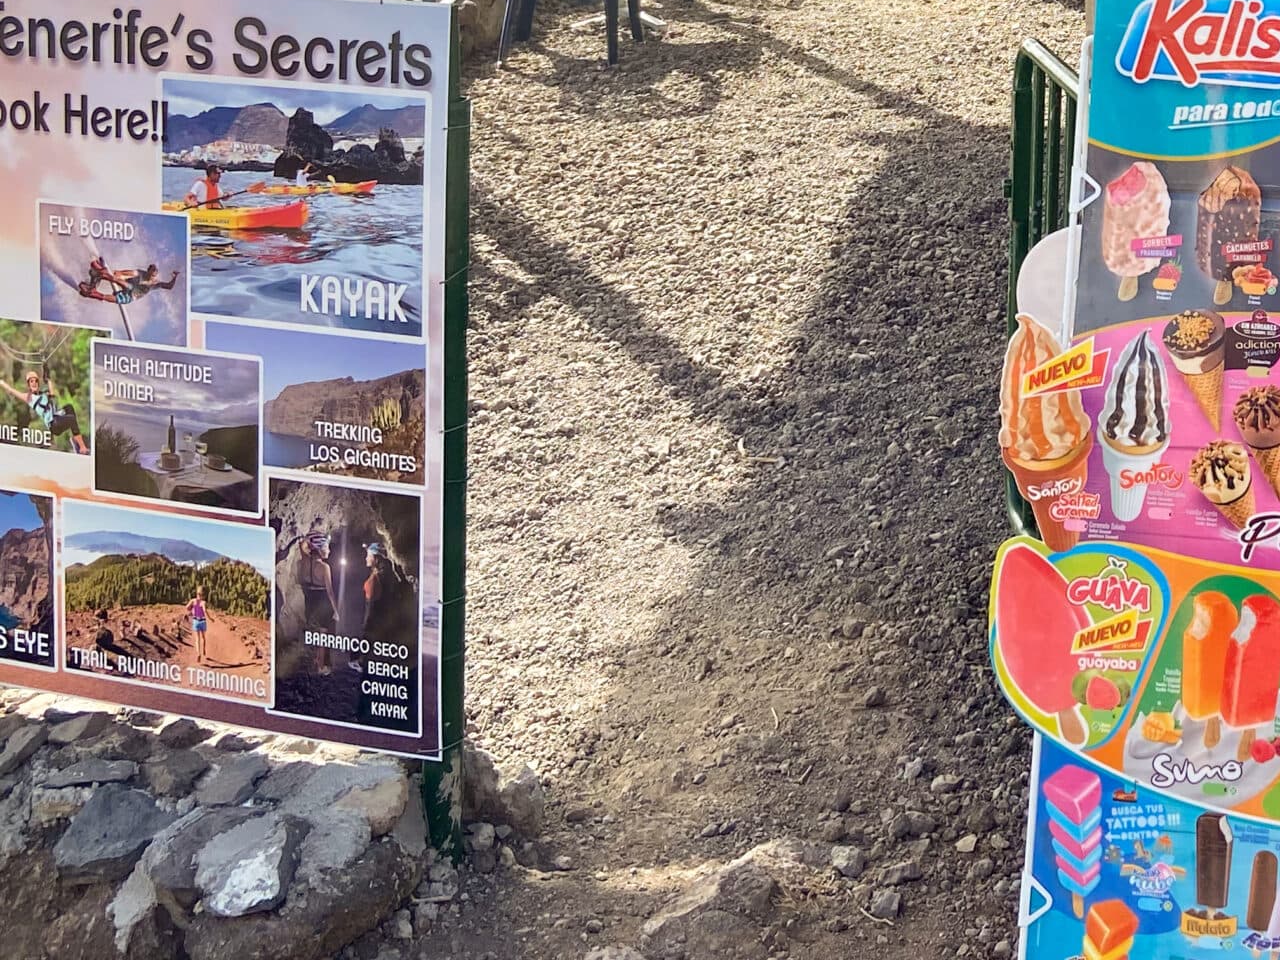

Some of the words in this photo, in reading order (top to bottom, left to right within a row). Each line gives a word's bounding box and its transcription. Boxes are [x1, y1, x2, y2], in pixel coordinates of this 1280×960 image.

[0, 1, 214, 71] enerife's
[232, 16, 433, 87] Secrets
[64, 93, 169, 142] Here!!
[1172, 102, 1228, 125] para
[49, 215, 73, 236] FLY
[80, 218, 135, 241] BOARD
[1226, 241, 1270, 254] CACAHUETES
[301, 274, 408, 323] KAYAK
[103, 354, 140, 375] HIGH
[145, 359, 213, 384] ALTITUDE
[1028, 352, 1087, 391] NUEVO
[103, 380, 154, 402] DINNER
[22, 427, 52, 446] RIDE
[314, 420, 383, 444] TREKKING
[310, 443, 340, 463] LOS
[343, 448, 417, 473] GIGANTES
[14, 628, 50, 657] EYE
[304, 630, 370, 654] BARRANCO
[373, 641, 409, 660] SECO
[1078, 619, 1132, 649] NUEVO
[71, 646, 113, 671] TRAIL
[118, 655, 181, 682] RUNNING
[186, 667, 266, 697] TRAINNING
[367, 660, 409, 680] BEACH
[1078, 656, 1137, 672] guayaba
[361, 680, 409, 700] CAVING
[371, 701, 408, 721] KAYAK
[1151, 753, 1243, 788] Sumo
[1105, 814, 1165, 830] TATTOOS
[1111, 806, 1143, 816] BUSCA
[1145, 804, 1164, 814] TUS
[1120, 830, 1160, 840] DENTRO
